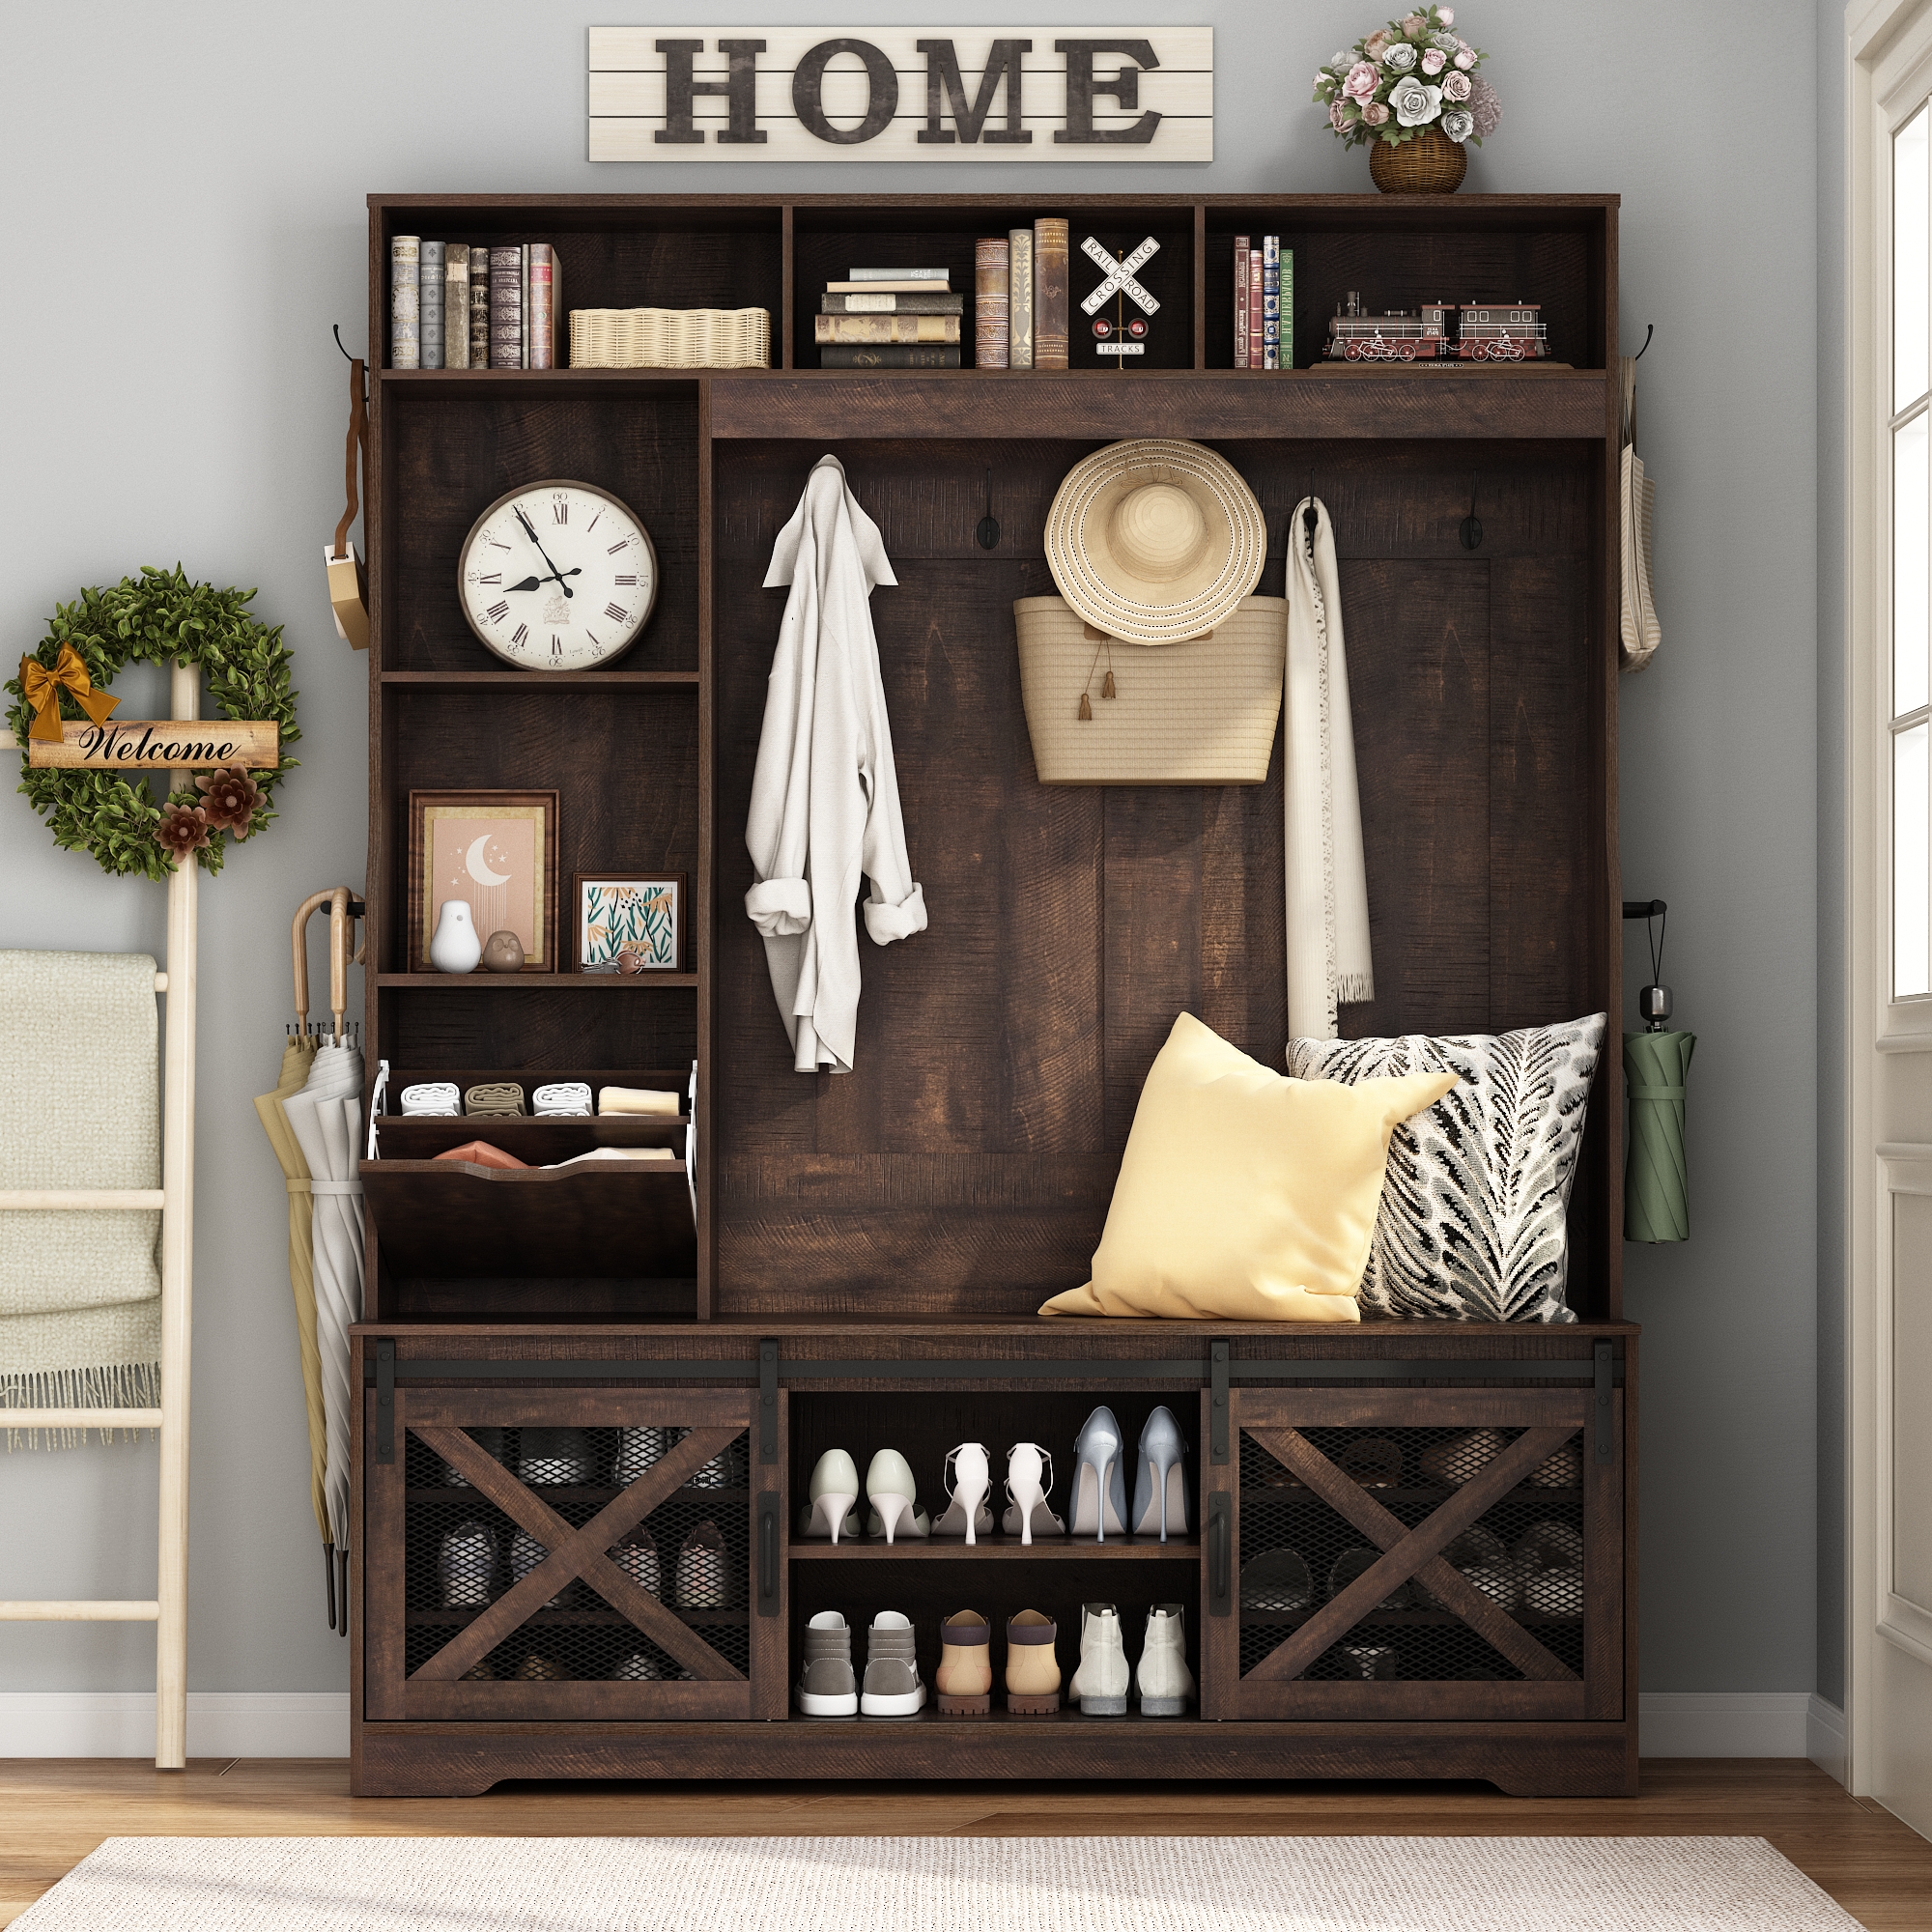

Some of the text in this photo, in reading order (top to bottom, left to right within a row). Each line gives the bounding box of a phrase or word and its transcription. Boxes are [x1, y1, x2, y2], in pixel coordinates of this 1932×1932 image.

[654, 38, 1162, 144] HOME
[1087, 242, 1155, 310] RAIL ROAD
[1088, 243, 1152, 308] CROSSING
[1101, 345, 1140, 354] TRACKS
[553, 492, 568, 501] 60
[552, 502, 568, 525] XII
[479, 529, 492, 545] 50
[627, 531, 639, 546] 10
[468, 571, 477, 585] 45
[639, 575, 649, 587] 15
[476, 612, 489, 626] 40
[624, 614, 638, 629] 20
[591, 644, 607, 659] 25
[549, 657, 564, 668] 30
[78, 724, 242, 761] Welcome
